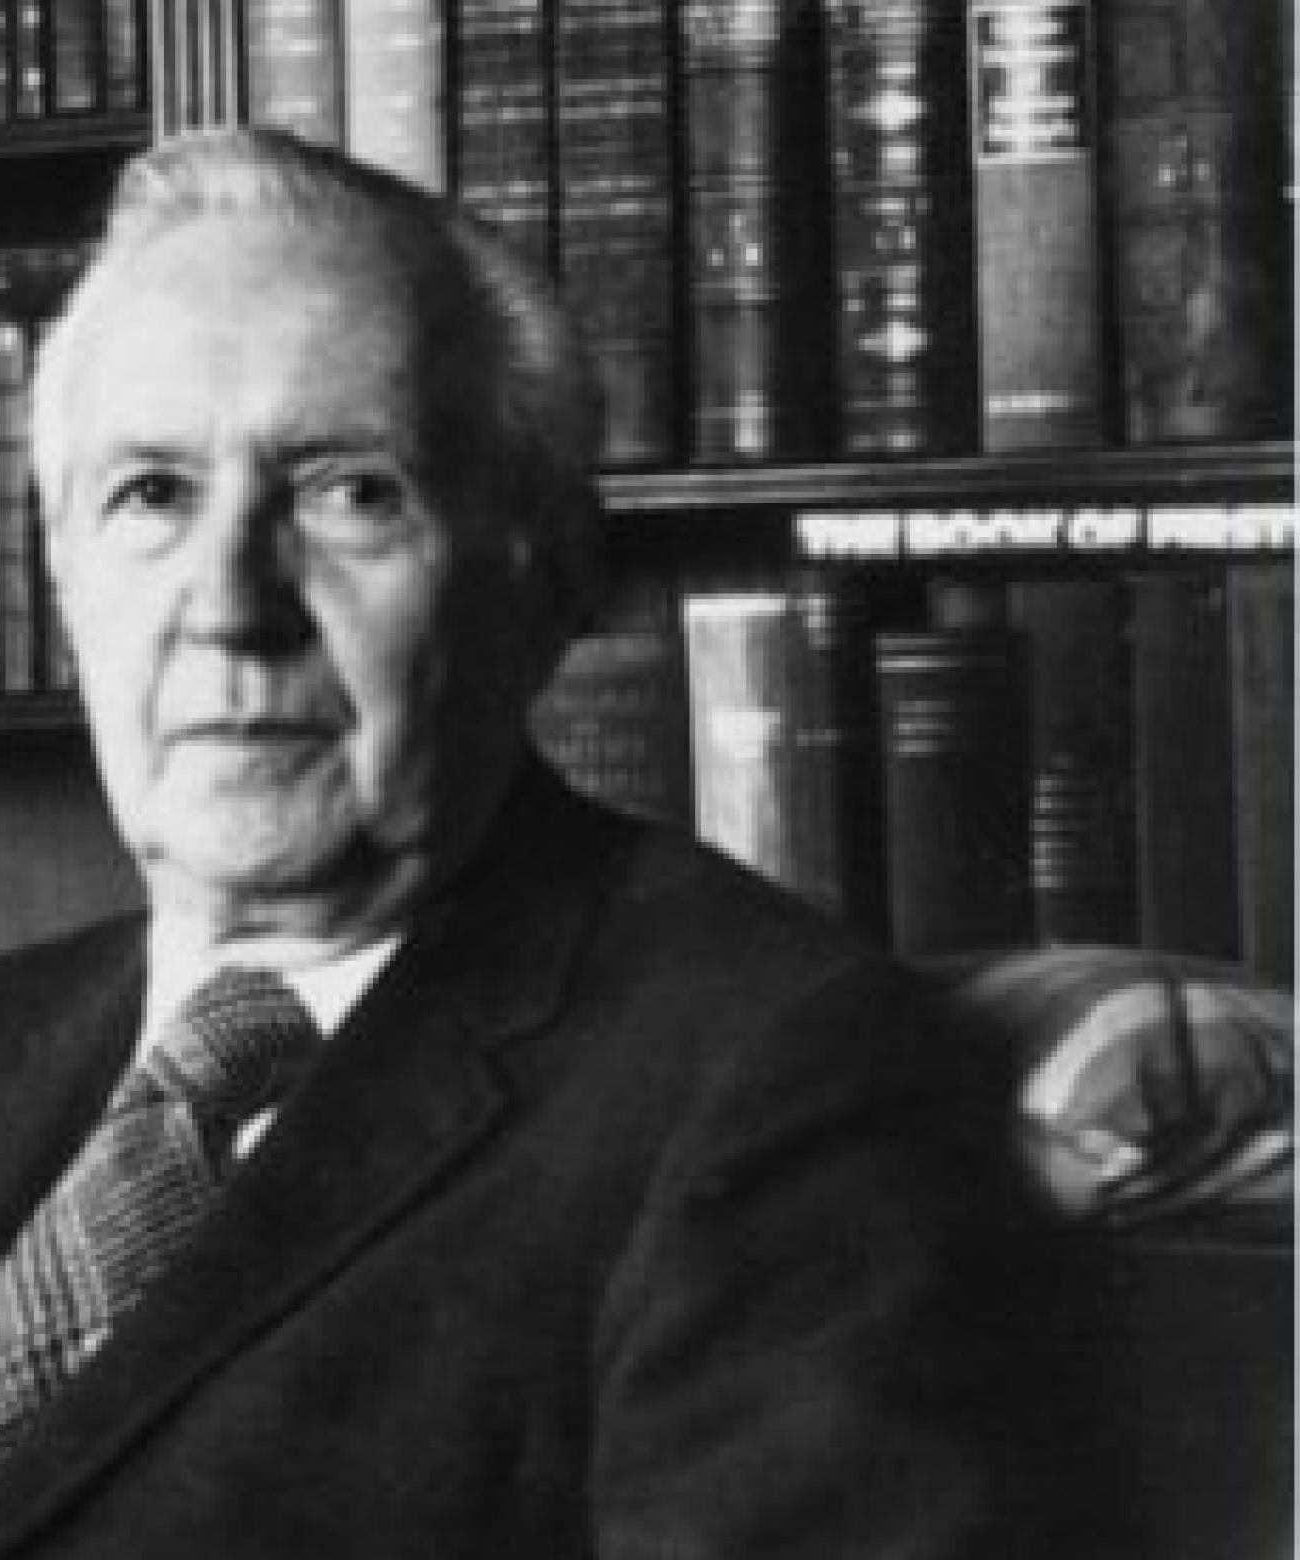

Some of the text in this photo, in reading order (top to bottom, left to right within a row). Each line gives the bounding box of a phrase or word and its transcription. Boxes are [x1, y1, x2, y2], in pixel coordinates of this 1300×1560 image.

[797, 512, 899, 557] THE
[905, 509, 1062, 552] BOOK
[1067, 507, 1137, 549] OF
